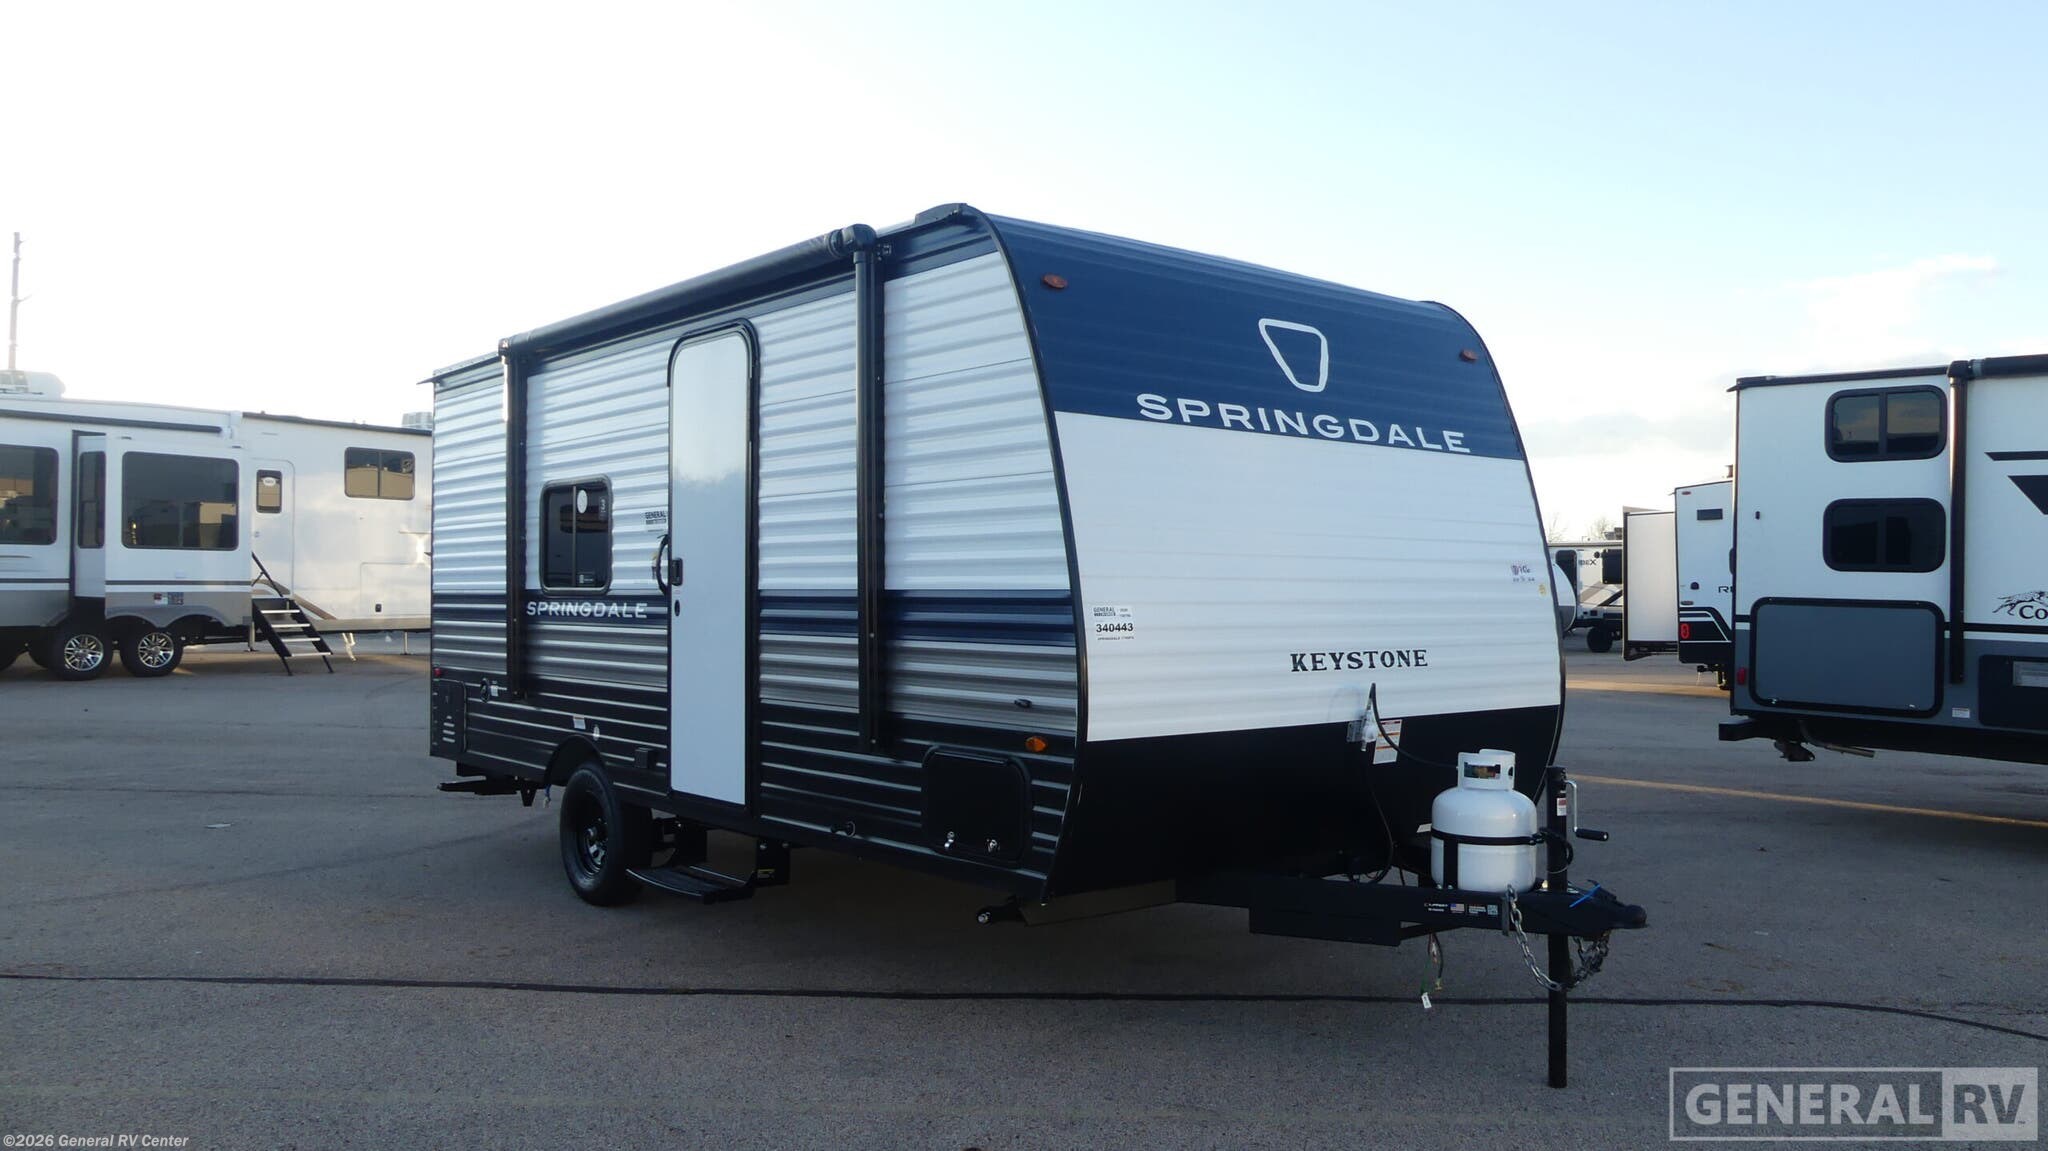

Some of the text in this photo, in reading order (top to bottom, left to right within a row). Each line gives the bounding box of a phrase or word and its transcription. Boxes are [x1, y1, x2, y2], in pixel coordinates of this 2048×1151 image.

[1136, 393, 1471, 453] SPRINGDALE
[526, 601, 648, 619] SPRINGDALE
[1096, 622, 1134, 633] 340443
[1290, 649, 1428, 673] KEYSTONE
